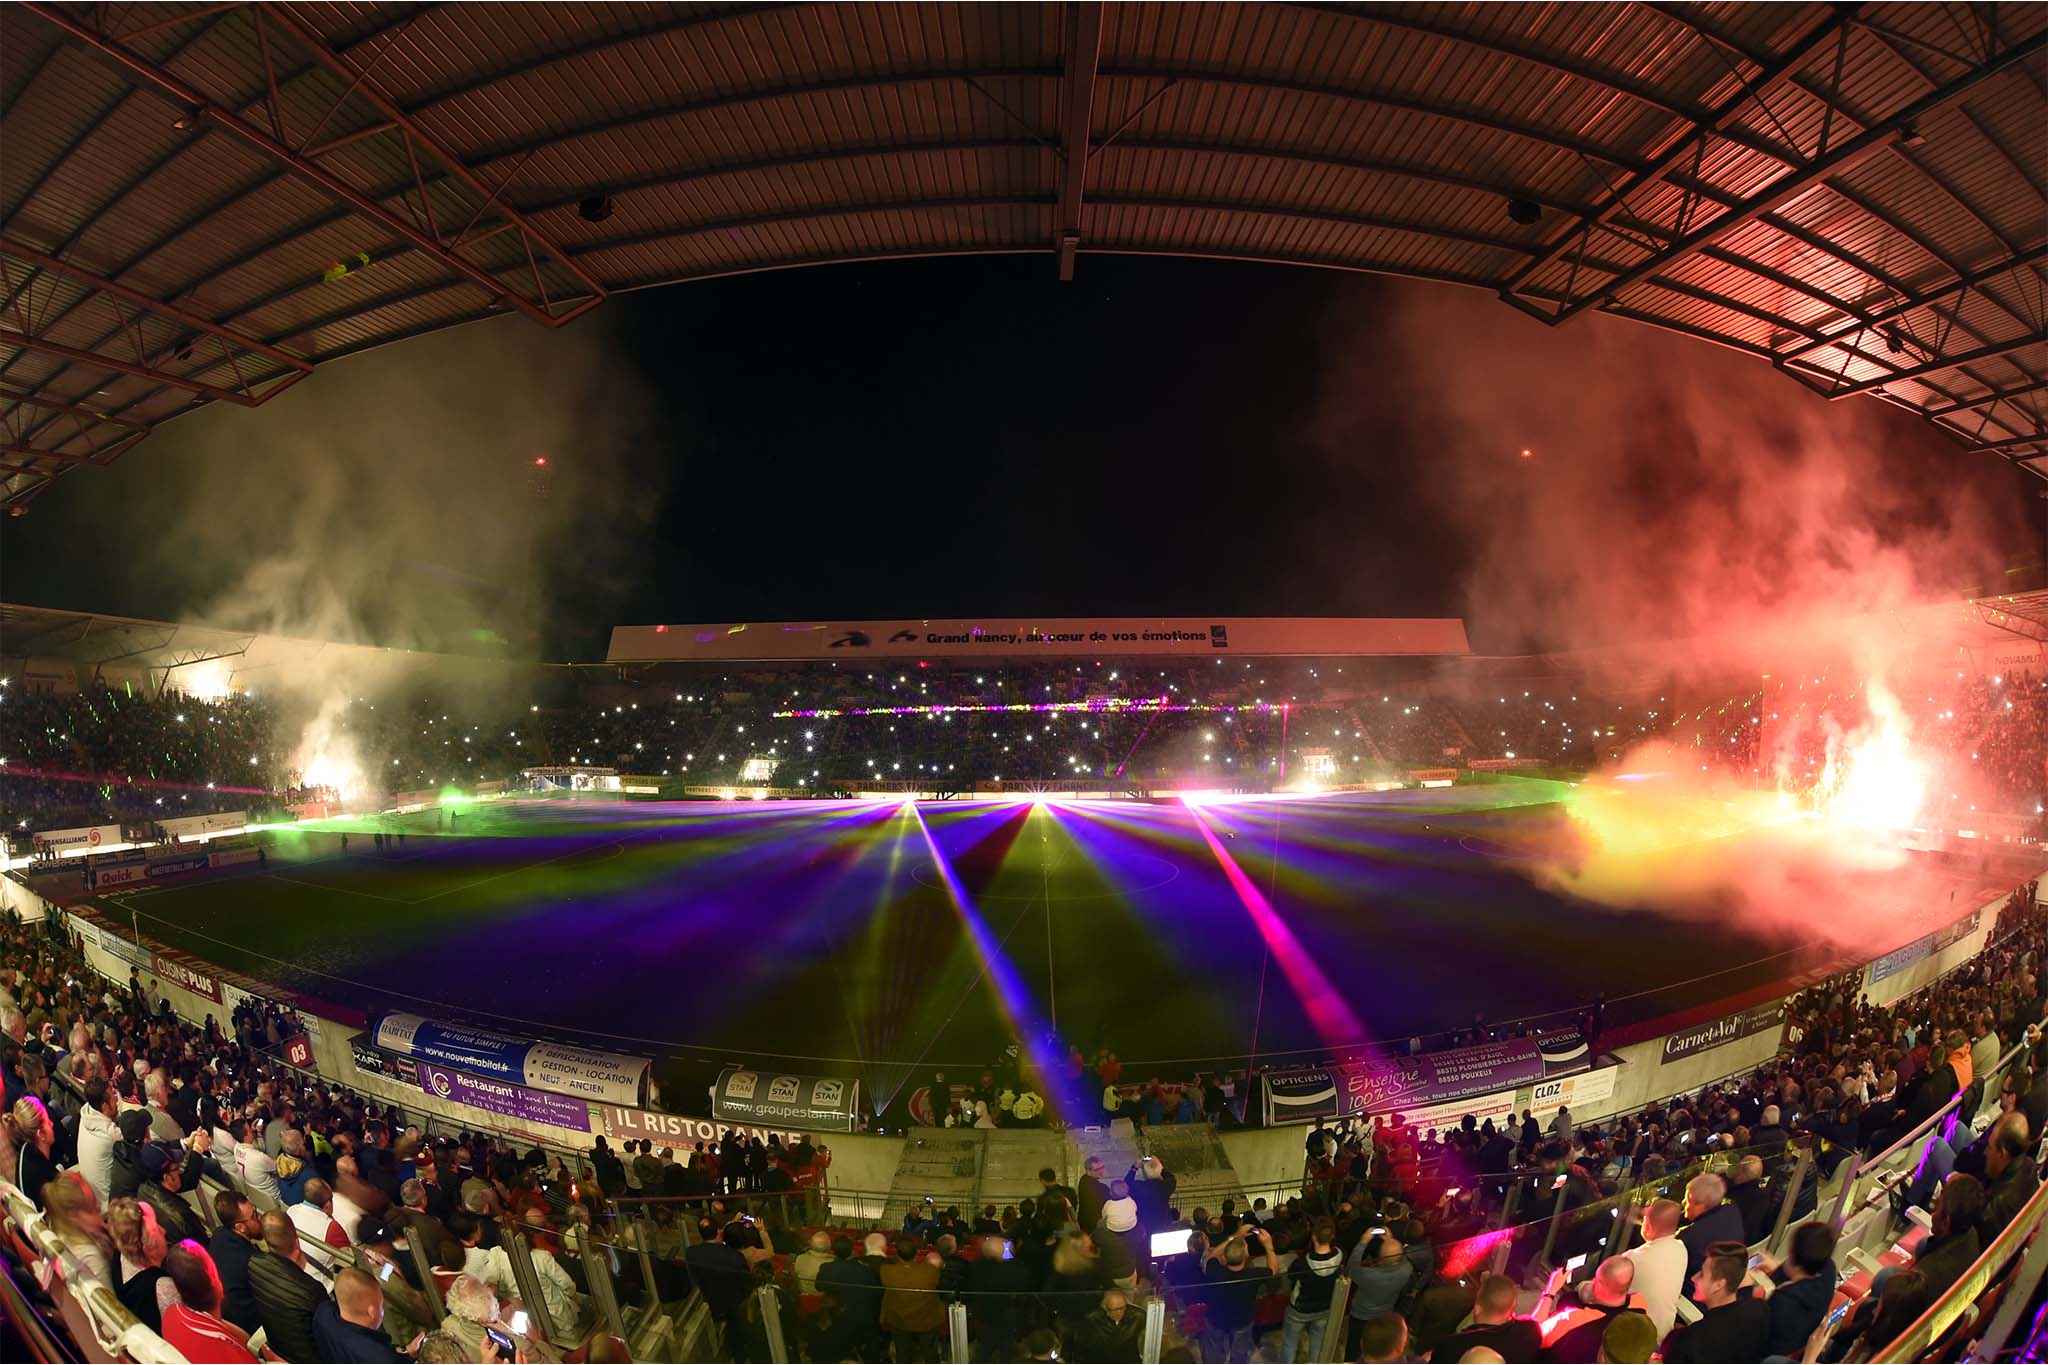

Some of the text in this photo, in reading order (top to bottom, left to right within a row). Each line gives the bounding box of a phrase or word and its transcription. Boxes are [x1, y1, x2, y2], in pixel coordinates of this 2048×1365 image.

[927, 633, 969, 643] Grand
[1089, 632, 1107, 642] de
[1112, 633, 1138, 641] vos
[1142, 629, 1207, 641] émotions
[101, 868, 133, 883] Quick
[157, 958, 188, 983] CUISINE
[188, 971, 213, 994] PLUS
[381, 1024, 414, 1040] HABITAT
[1537, 1032, 1582, 1046] OPTICIENS
[1666, 1026, 1714, 1054] Carnet
[1719, 1016, 1738, 1038] Vol
[1789, 1025, 1804, 1043] 06
[451, 1033, 473, 1043] FUTUR
[473, 1038, 501, 1049] SIMPLE
[291, 1044, 307, 1063] 03
[1467, 1055, 1479, 1063] VAL
[542, 1061, 578, 1075] GESTION
[586, 1069, 633, 1085] LOCATION
[1272, 1073, 1329, 1086] OPTICIENS
[1461, 1069, 1494, 1080] POUXEUX
[456, 1073, 514, 1098] Restaurant
[539, 1073, 561, 1085] NEUF
[569, 1080, 605, 1094] ANCIEN
[728, 1083, 752, 1092] STAN
[1348, 1070, 1419, 1095] Enseigne
[772, 1088, 795, 1097] STAN
[815, 1093, 839, 1101] STAN
[1394, 1098, 1411, 1106] Chez
[1461, 1084, 1492, 1095] Opticiens
[1492, 1080, 1506, 1089] sont
[524, 1104, 548, 1114] 54000
[616, 1109, 637, 1128] IL
